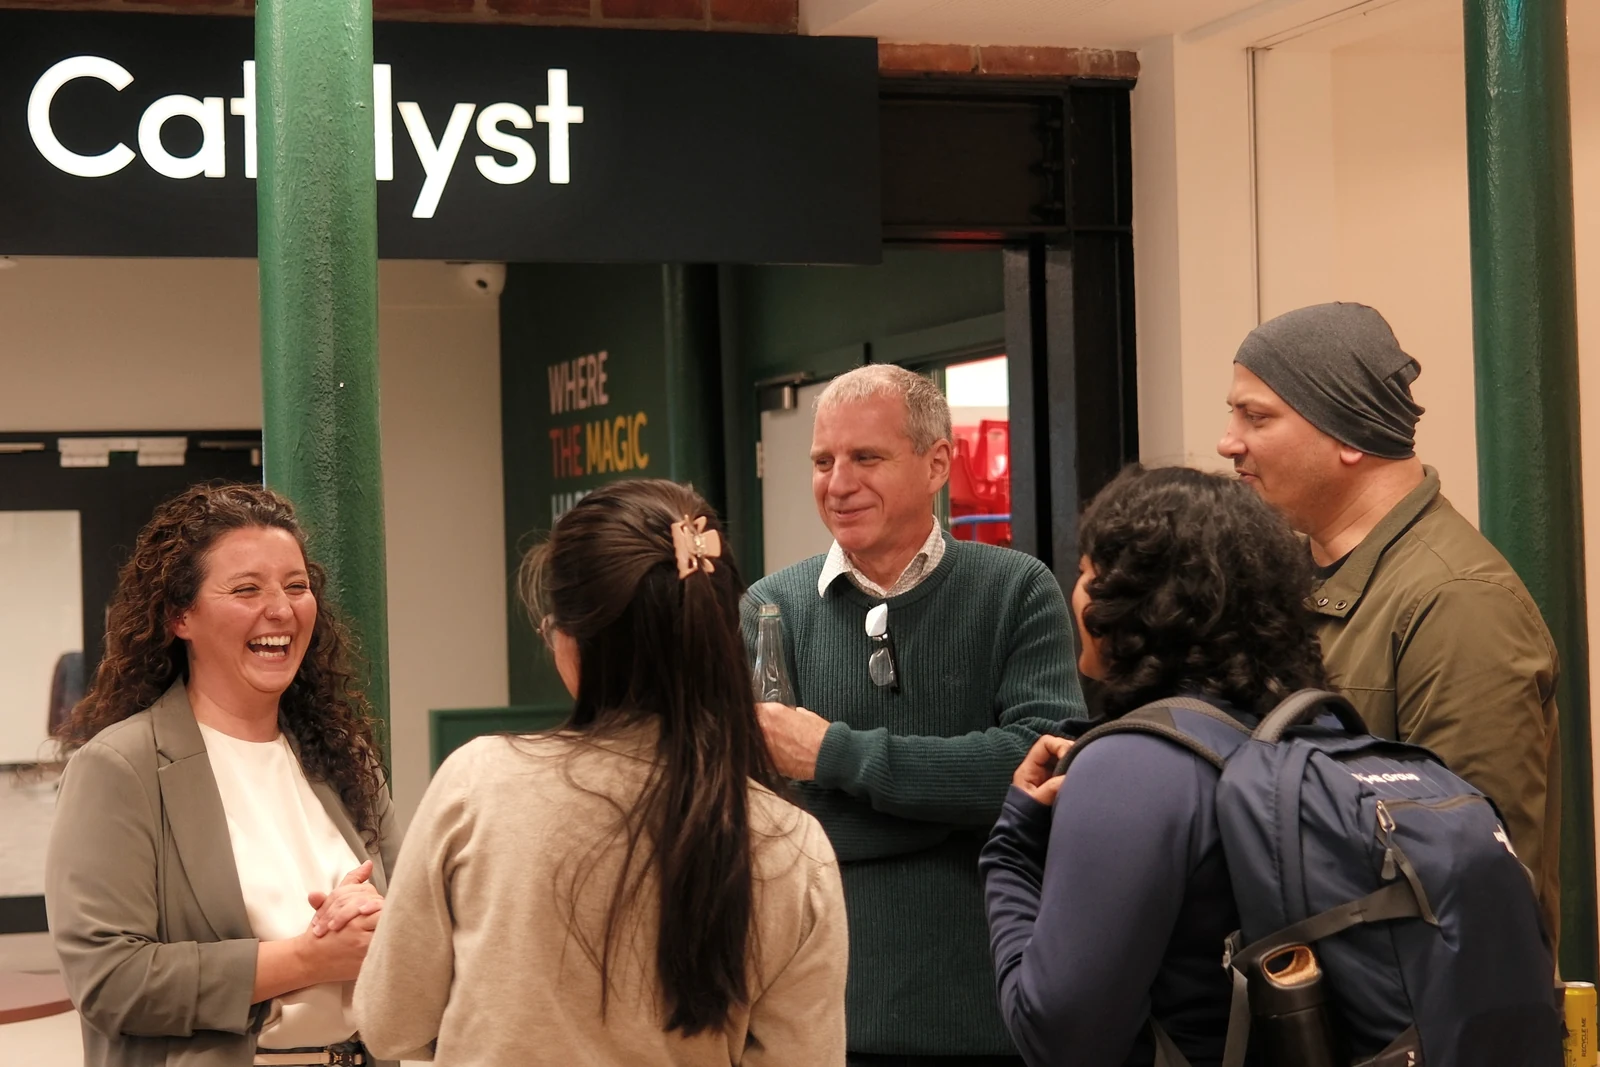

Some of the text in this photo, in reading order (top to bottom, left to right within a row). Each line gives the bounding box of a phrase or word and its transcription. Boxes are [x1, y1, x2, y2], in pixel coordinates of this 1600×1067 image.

[27, 55, 584, 219] Catlyst
[549, 351, 609, 415] WHERE
[549, 411, 649, 478] THE MAGIC
[1581, 1017, 1587, 1027] ME
